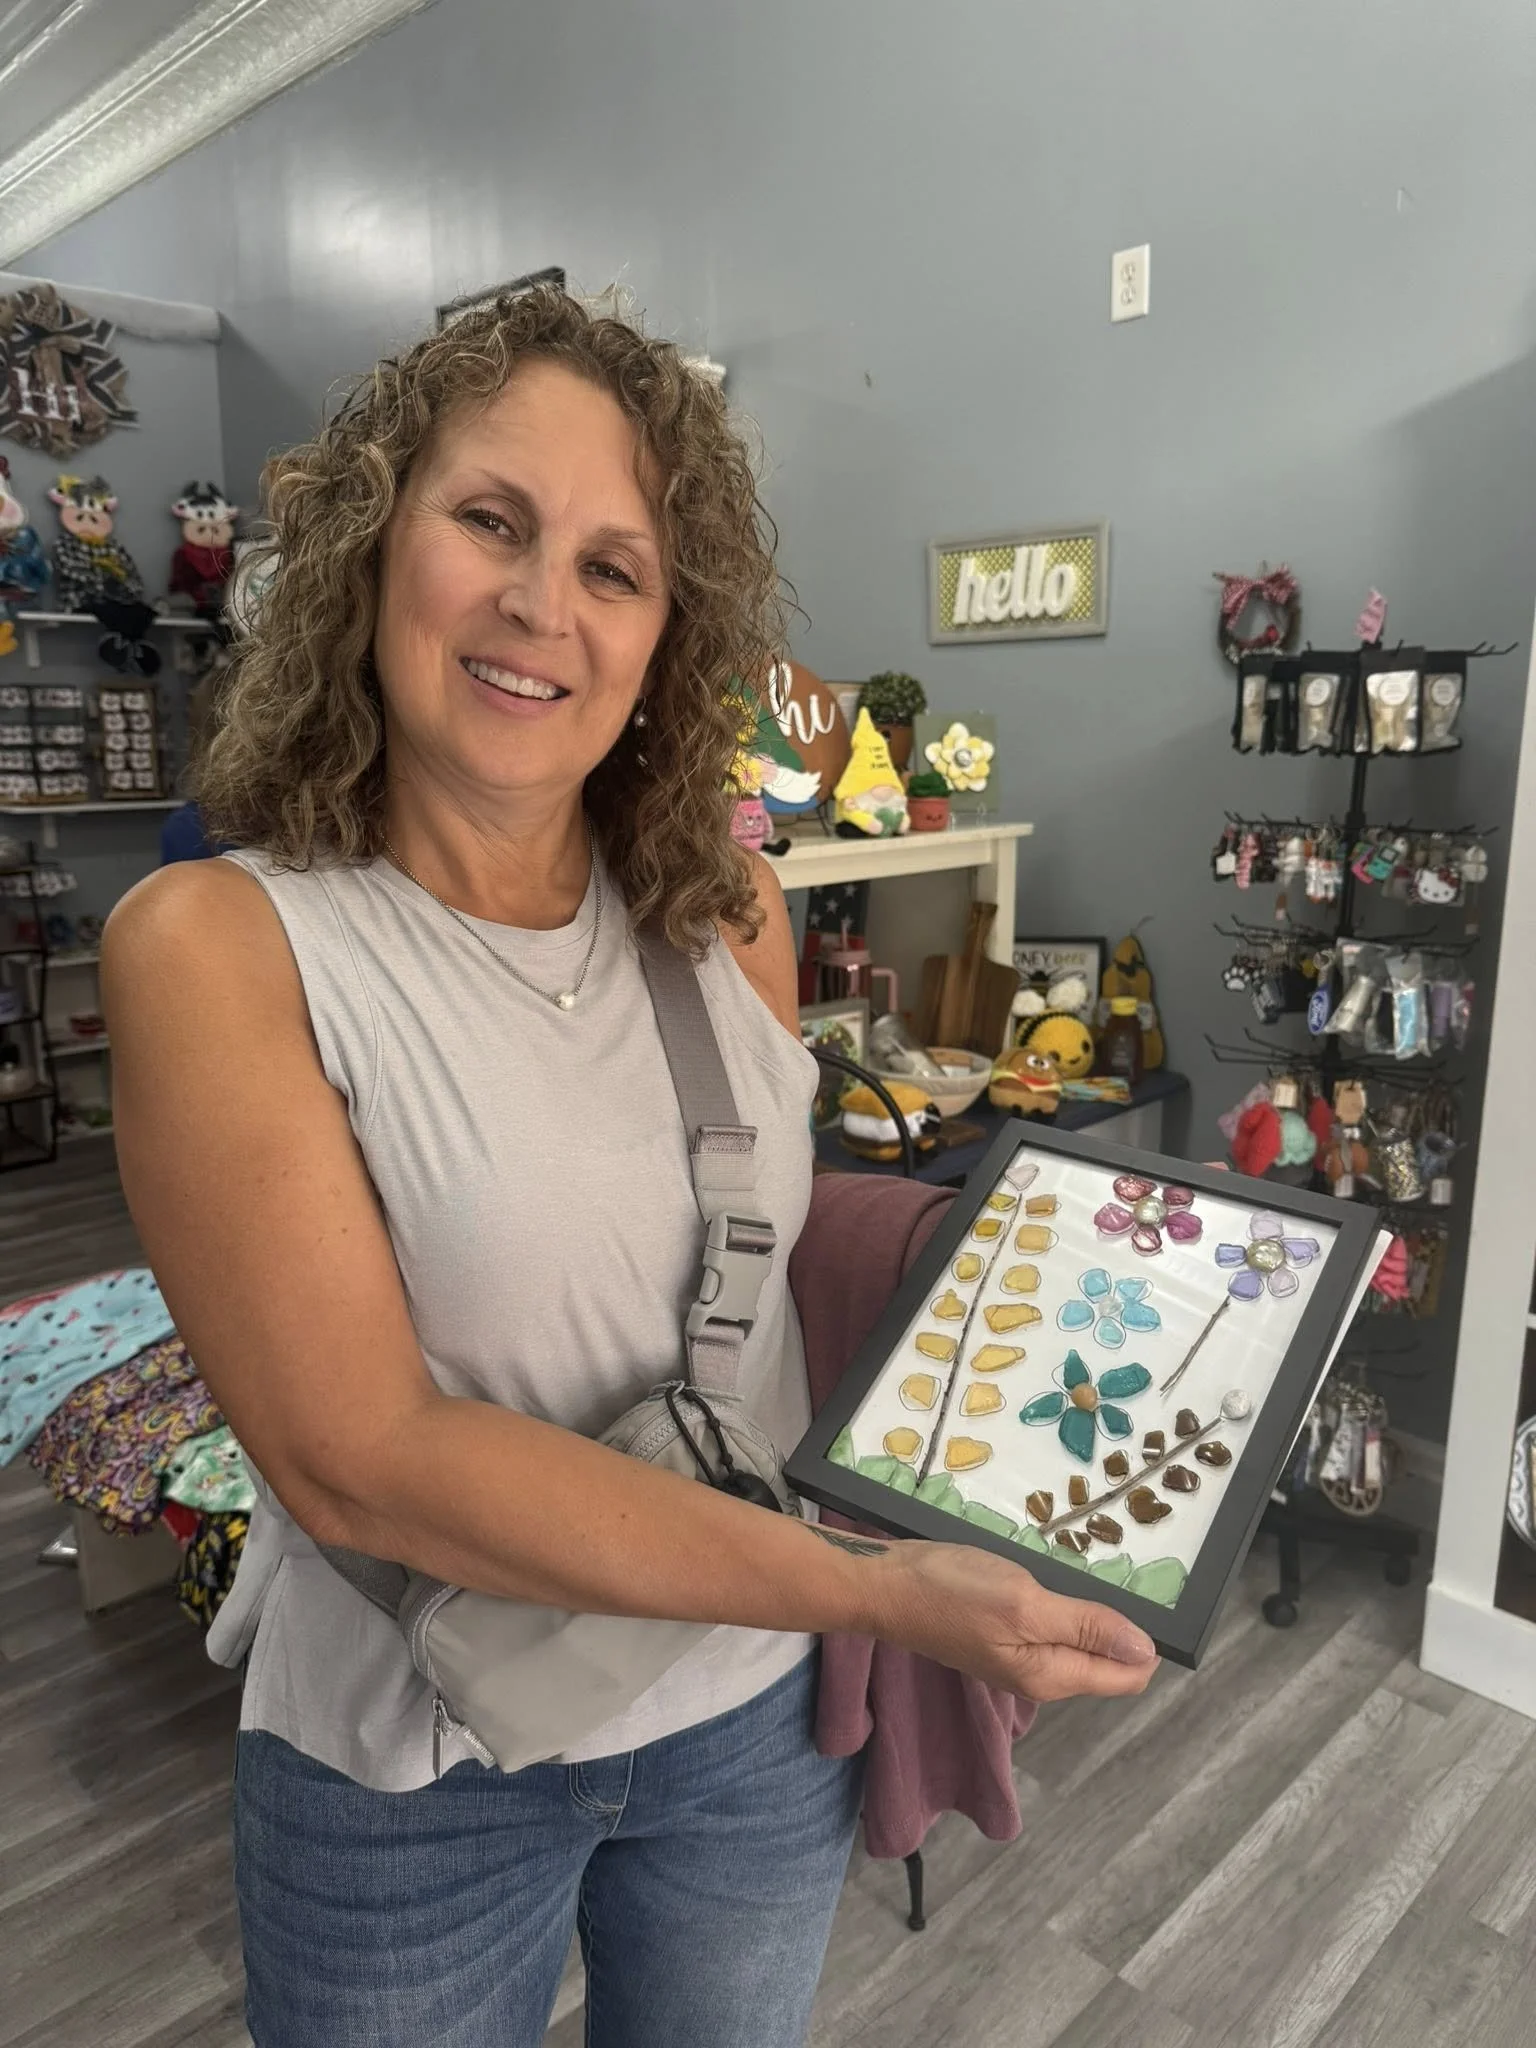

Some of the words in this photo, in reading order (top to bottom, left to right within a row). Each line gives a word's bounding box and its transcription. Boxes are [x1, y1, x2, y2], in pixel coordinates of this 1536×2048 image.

[953, 544, 1078, 625] hello
[769, 661, 836, 745] hi
[1012, 949, 1051, 966] ONEY
[464, 1729, 495, 1762] lululemon
